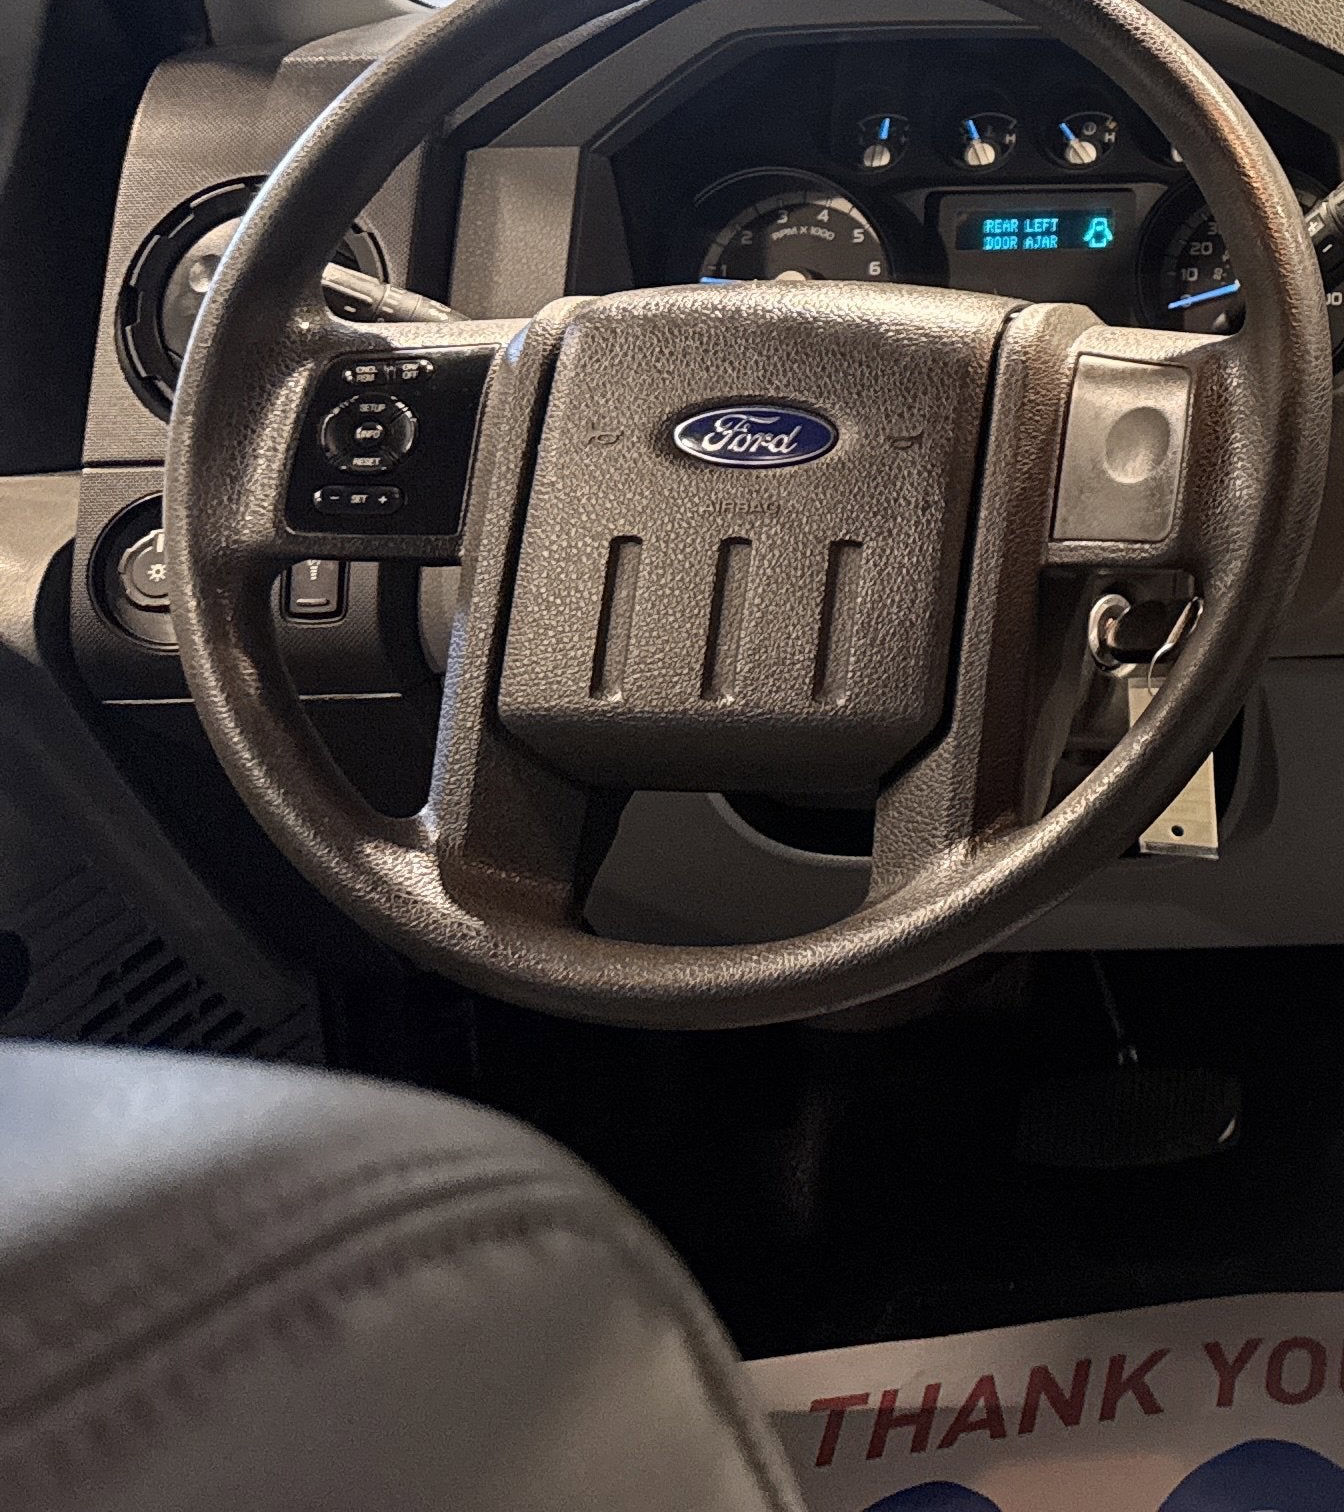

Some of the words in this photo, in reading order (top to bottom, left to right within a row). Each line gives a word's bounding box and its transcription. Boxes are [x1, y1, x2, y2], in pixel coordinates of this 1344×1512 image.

[776, 209, 789, 224] 3
[817, 208, 830, 223] 4
[983, 218, 1019, 232] REAR
[1024, 218, 1060, 232] LEFT
[741, 230, 753, 245] 2
[770, 227, 797, 242] RPM
[809, 225, 836, 241] 1000
[852, 228, 865, 244] 5
[983, 236, 1018, 250] DOOR
[1024, 235, 1059, 249] AJAR
[1189, 241, 1213, 256] 20
[868, 260, 881, 276] 6
[1180, 267, 1199, 282] 10
[402, 370, 419, 380] OFF
[359, 403, 387, 413] SETUP
[702, 413, 803, 454] Ford
[352, 457, 382, 467] RESET
[350, 494, 369, 504] SET
[808, 1346, 1174, 1468] THANK
